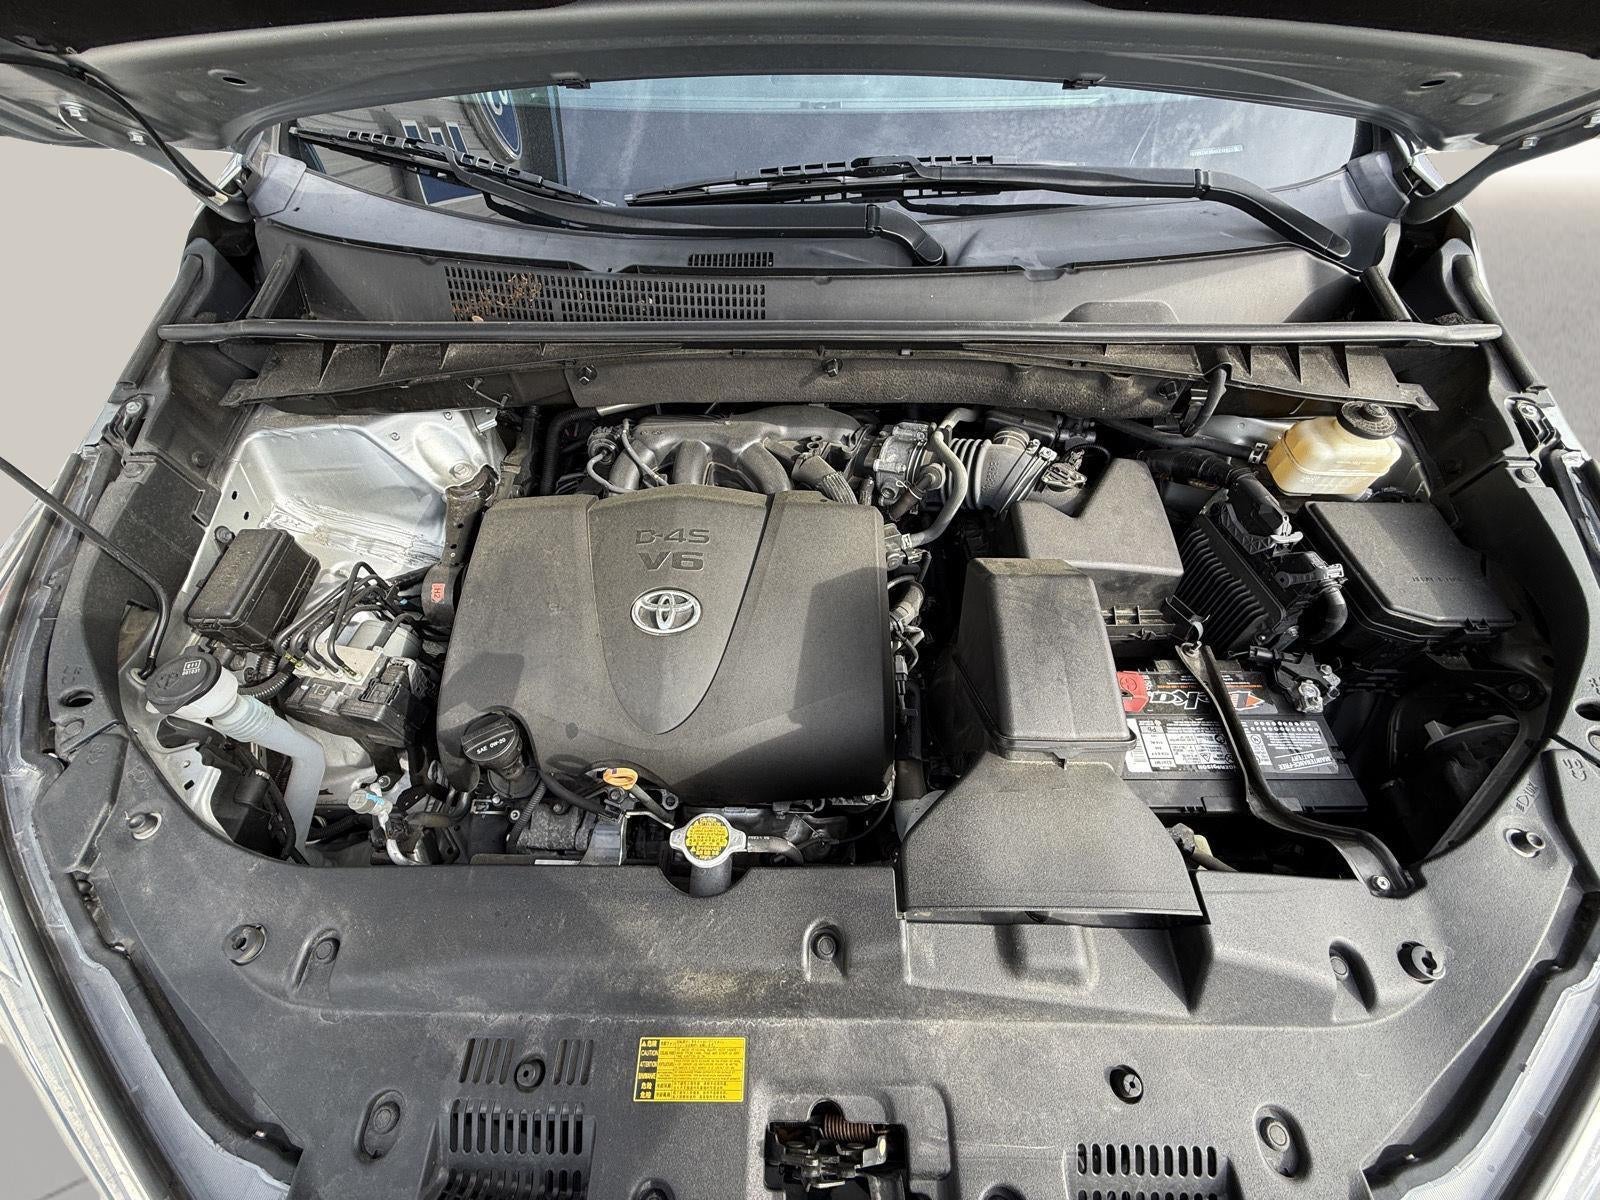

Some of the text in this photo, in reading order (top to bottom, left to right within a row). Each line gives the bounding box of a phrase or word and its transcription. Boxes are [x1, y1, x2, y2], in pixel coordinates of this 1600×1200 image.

[635, 528, 710, 545] D-4S
[638, 551, 704, 571] V6
[433, 587, 441, 599] H2
[476, 737, 506, 755] SAE 0W-20
[1277, 756, 1332, 771] MAINTENANCE-FREE
[1290, 753, 1314, 763] BATTERY
